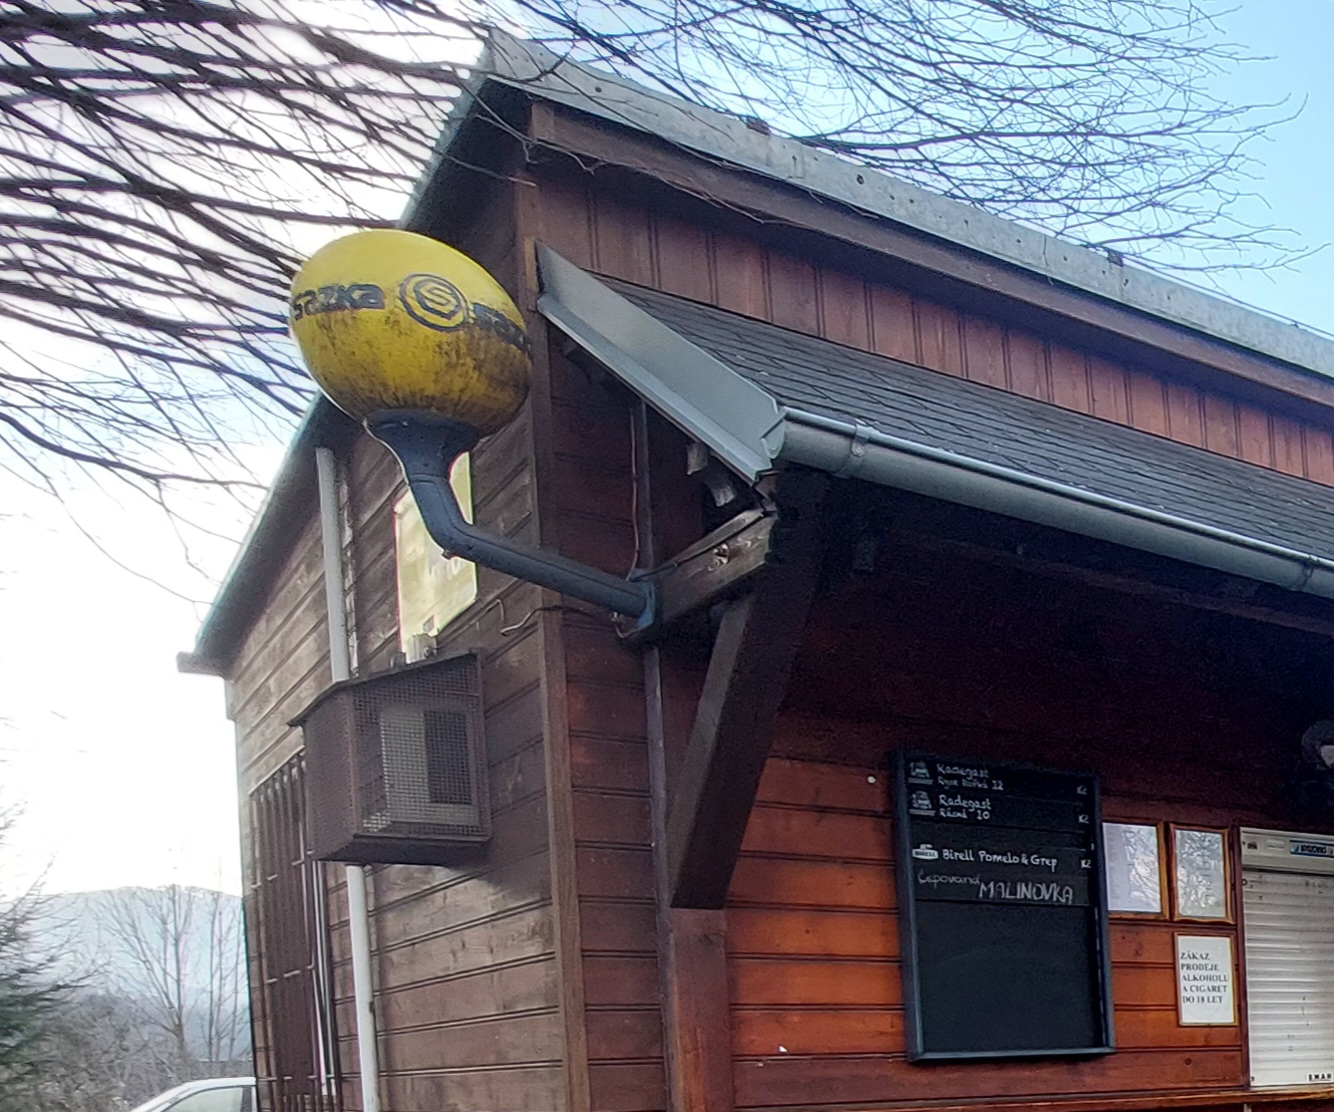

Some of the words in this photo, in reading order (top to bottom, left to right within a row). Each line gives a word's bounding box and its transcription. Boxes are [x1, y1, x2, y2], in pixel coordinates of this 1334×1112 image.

[991, 779, 1004, 791] 12
[938, 794, 992, 812] Radegast
[976, 810, 990, 821] 10
[942, 848, 974, 862] Birell
[978, 851, 1020, 865] Pomelo
[1030, 855, 1058, 873] Grep
[978, 880, 1074, 905] MALINOVKA
[1180, 950, 1210, 961] ZÁKAZ
[1180, 962, 1219, 972] PRODEJE
[1182, 974, 1228, 983] ALKOHOLU
[1183, 985, 1189, 993] A
[1189, 984, 1228, 994] CIGARET
[1182, 995, 1195, 1005] DO
[1197, 995, 1206, 1005] 18
[1206, 995, 1223, 1005] LET
